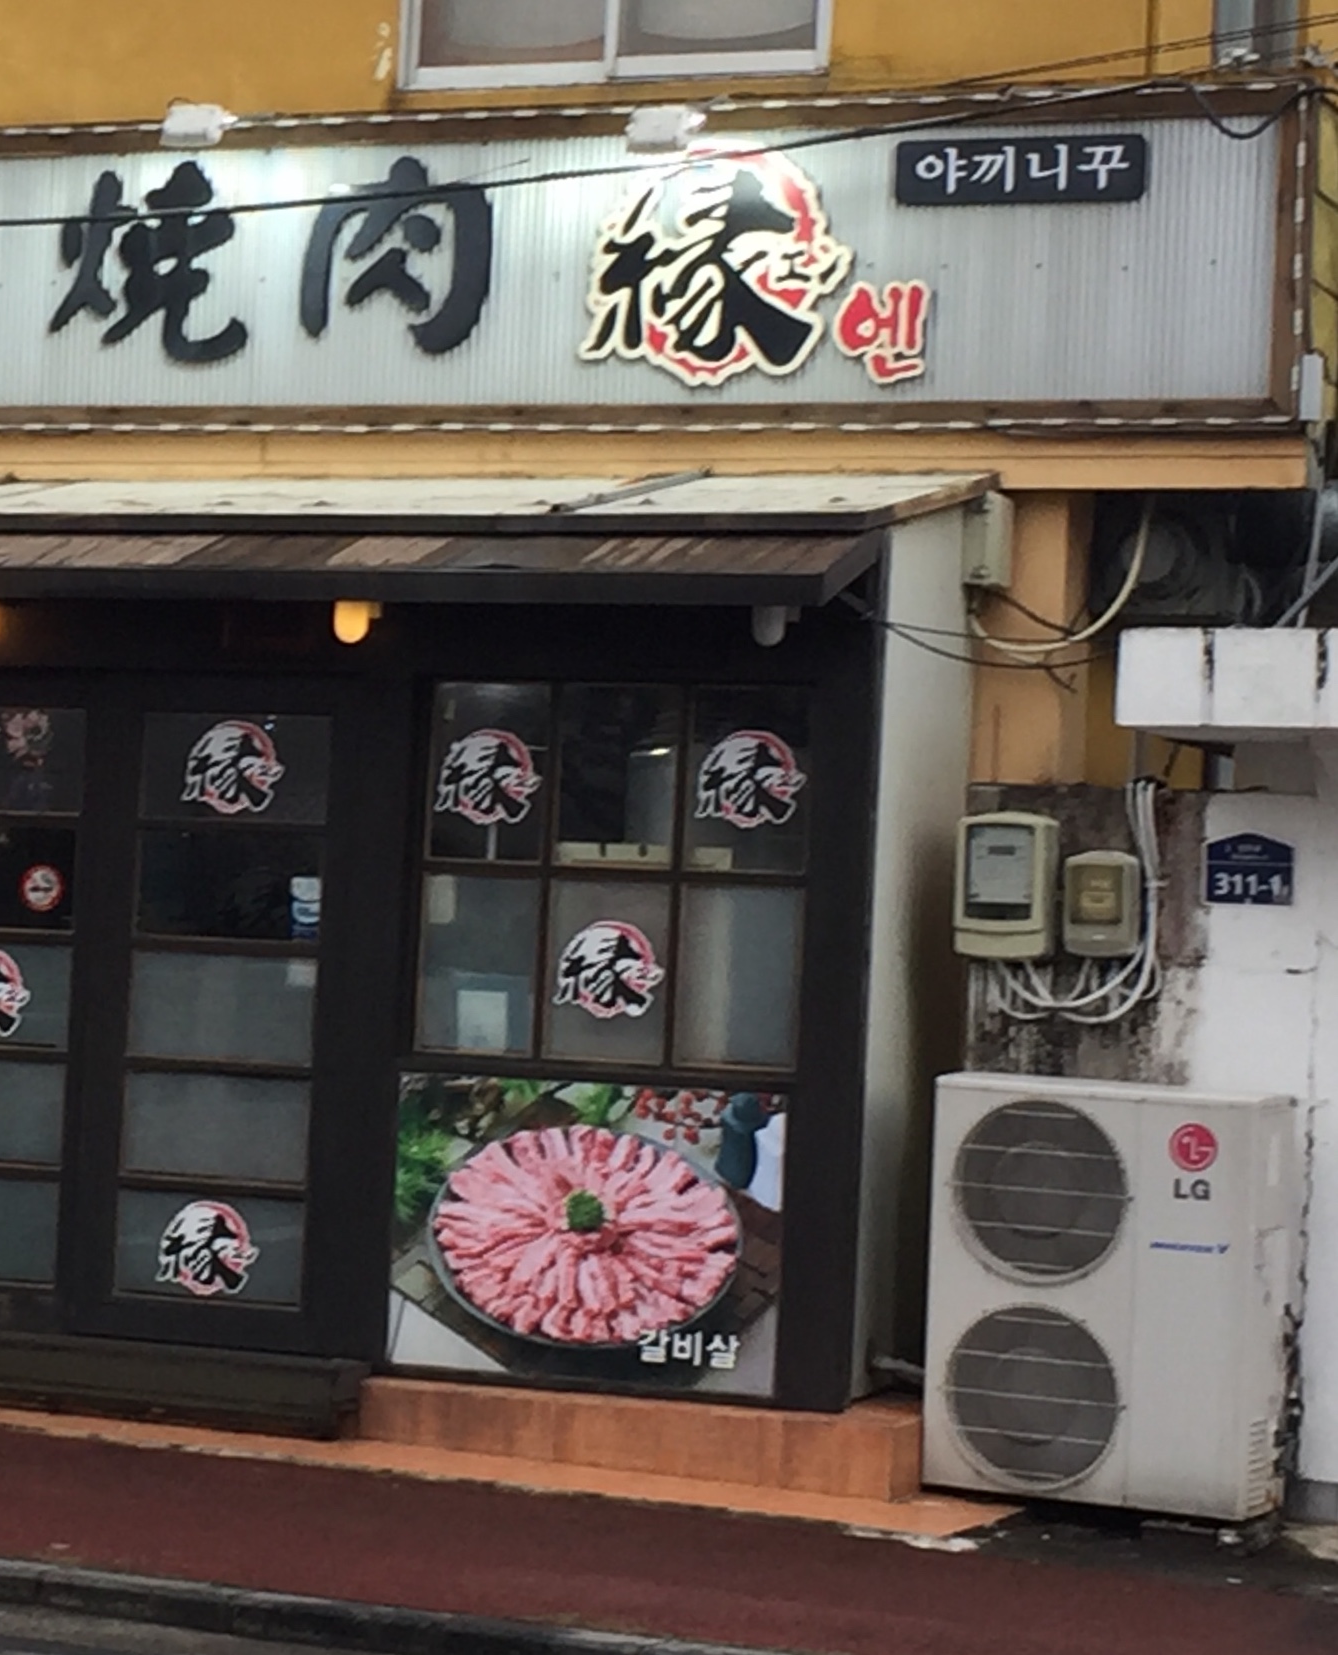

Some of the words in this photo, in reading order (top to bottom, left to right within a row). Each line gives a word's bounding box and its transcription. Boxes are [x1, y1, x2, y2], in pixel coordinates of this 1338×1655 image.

[915, 143, 1131, 195] 야끼니꾸
[840, 286, 926, 380] 엔
[1213, 871, 1283, 897] 311-1
[1173, 1178, 1211, 1200] LG
[637, 1328, 741, 1370] 갈비살
